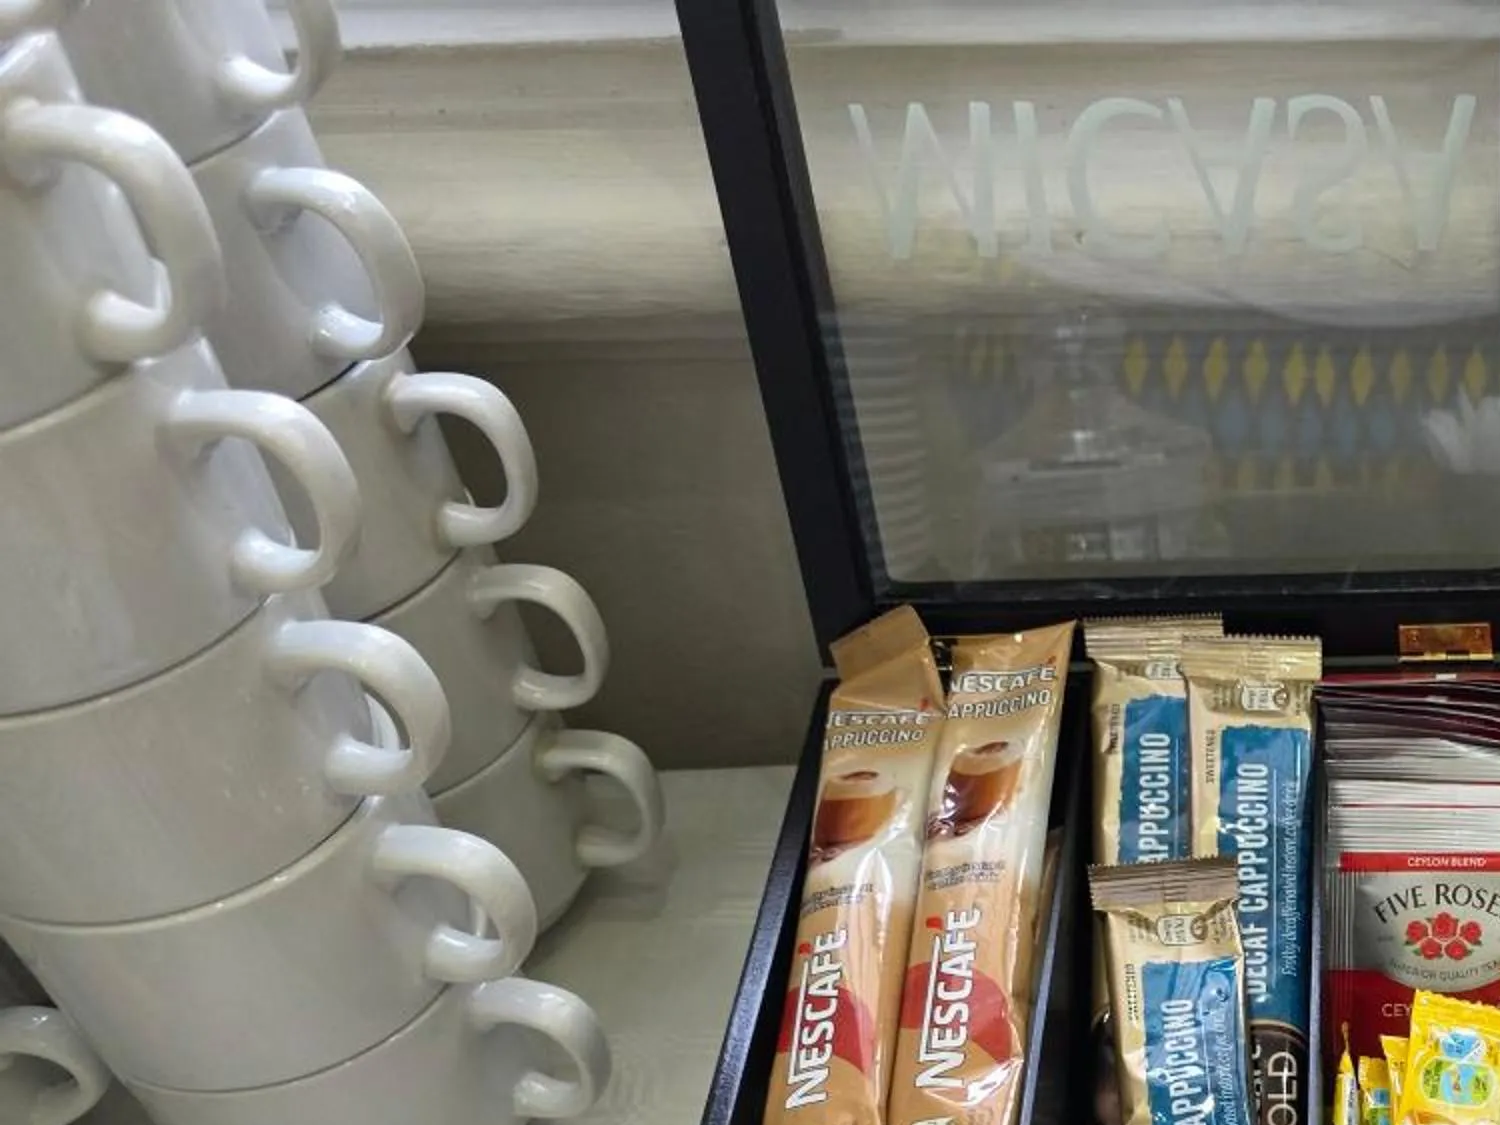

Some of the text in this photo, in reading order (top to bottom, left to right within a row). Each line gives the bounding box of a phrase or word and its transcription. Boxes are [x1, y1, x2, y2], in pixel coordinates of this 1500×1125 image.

[947, 688, 1051, 720] APPUCCINO
[824, 729, 925, 750] PPUCCINO
[1138, 732, 1171, 864] APPUCCINO
[1237, 762, 1269, 912] CAPPUCCINO
[1374, 885, 1428, 924] FIVE
[1381, 1003, 1411, 1018] CEY
